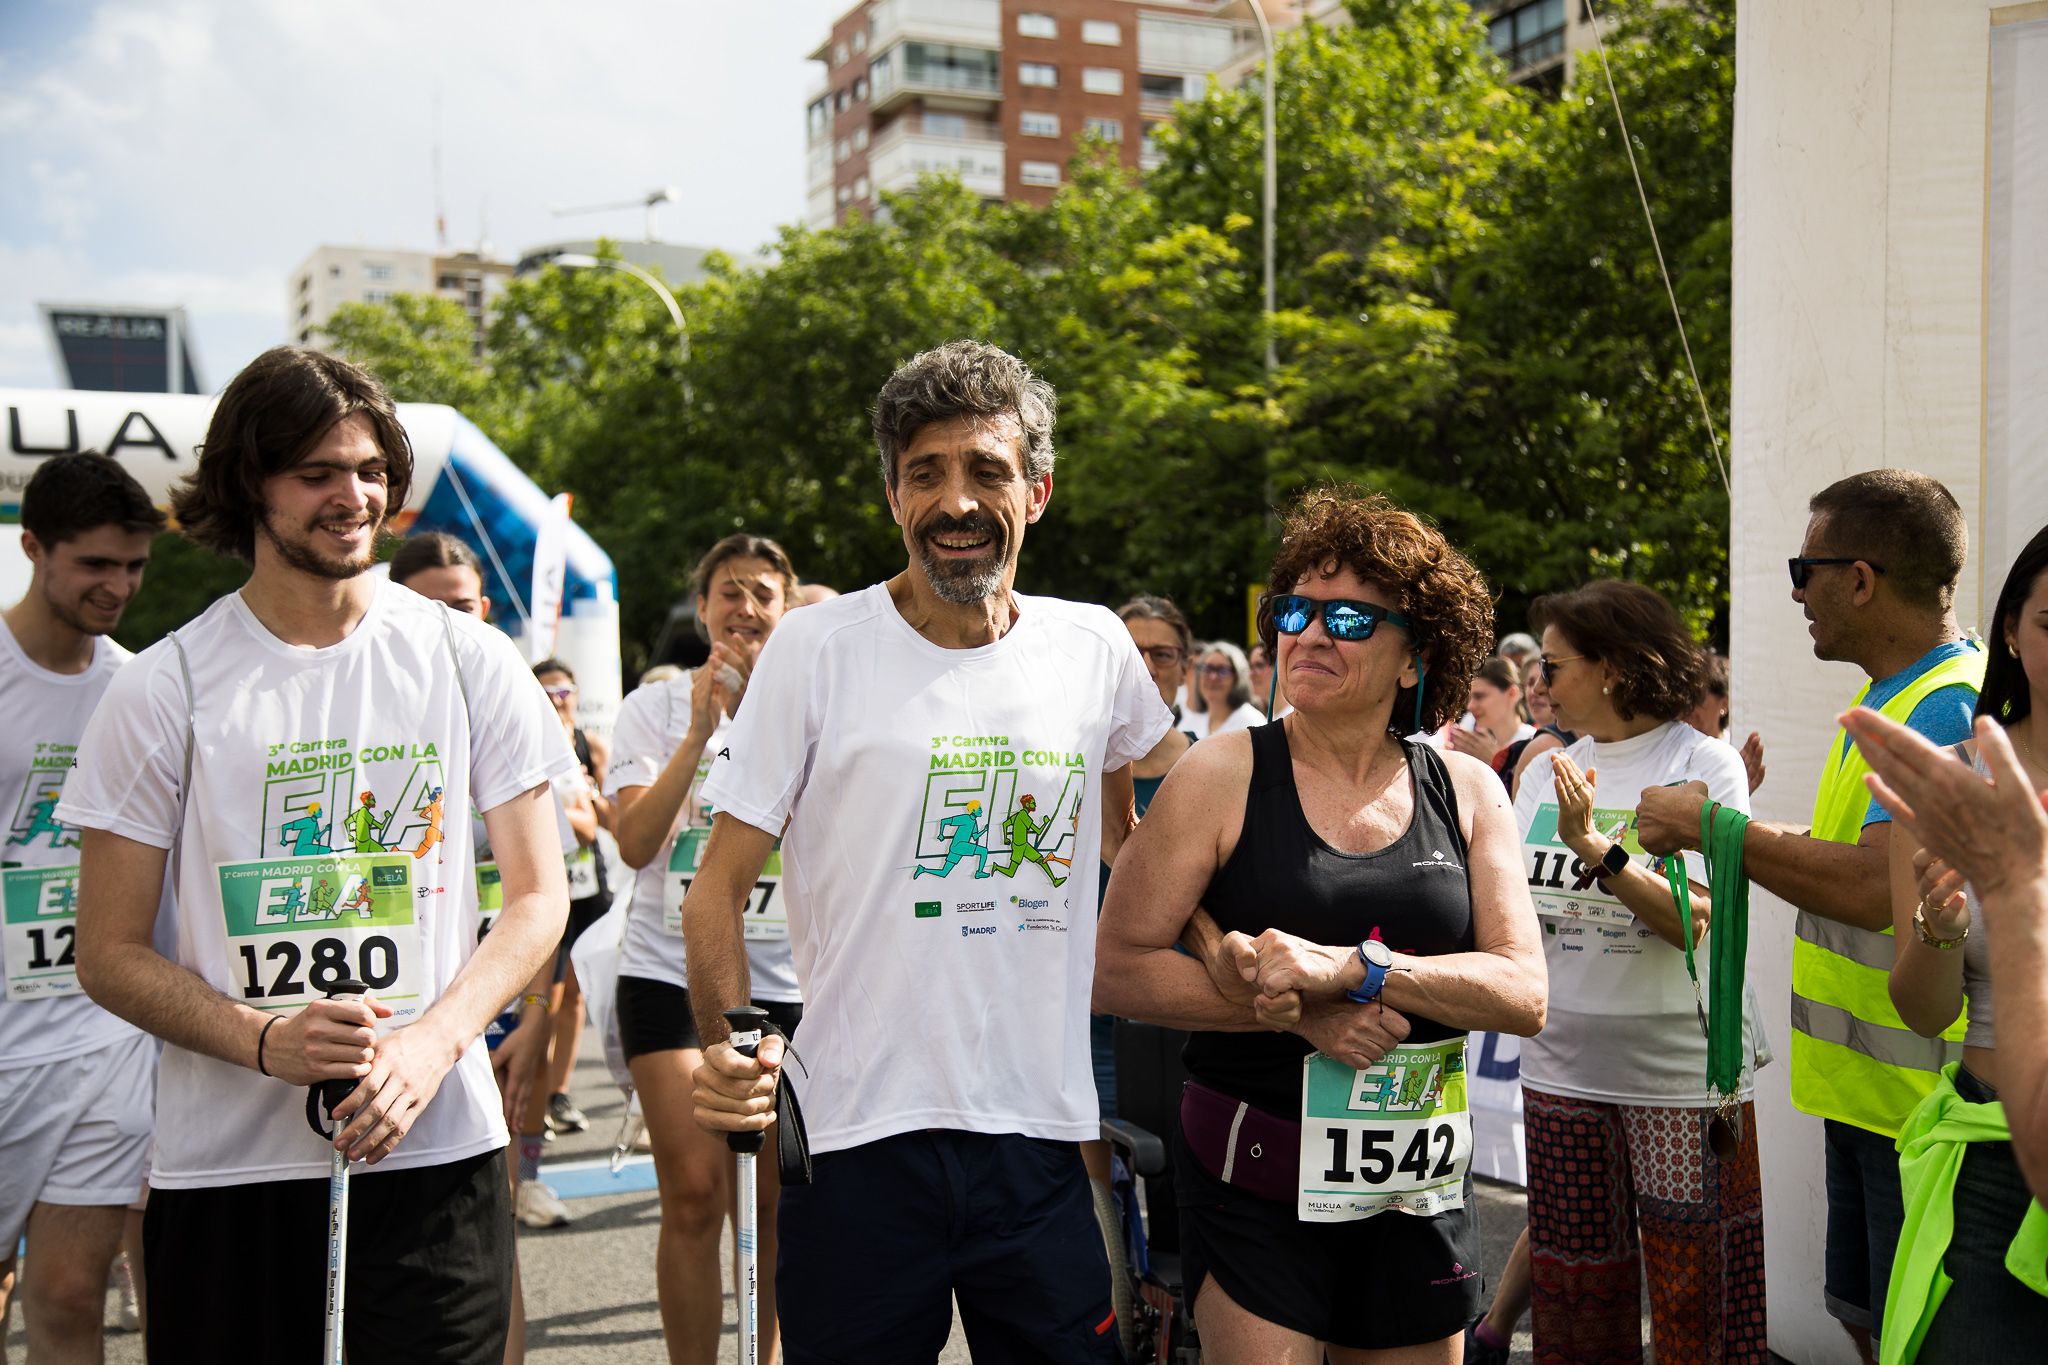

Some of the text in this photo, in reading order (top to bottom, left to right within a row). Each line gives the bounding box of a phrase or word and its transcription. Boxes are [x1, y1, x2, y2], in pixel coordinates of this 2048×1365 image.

[289, 738, 347, 754] Carrera
[952, 735, 1009, 747] Carrera
[266, 743, 438, 778] MADRID CON LA
[930, 750, 1085, 770] MADRID CON LA
[232, 870, 259, 878] Carrera
[262, 865, 314, 877] MADRID
[317, 862, 343, 873] CON
[345, 862, 361, 872] LA
[1528, 851, 1626, 896] 119
[255, 874, 373, 926] ELA
[1018, 899, 1049, 910] Biogen
[969, 926, 997, 935] MADRID
[1602, 929, 1627, 938] Biogen
[239, 935, 399, 998] 1280
[1375, 1052, 1441, 1064] DRID CON LA
[1346, 1064, 1443, 1112] ELA
[1324, 1123, 1456, 1184] 1542
[748, 1264, 757, 1296] light
